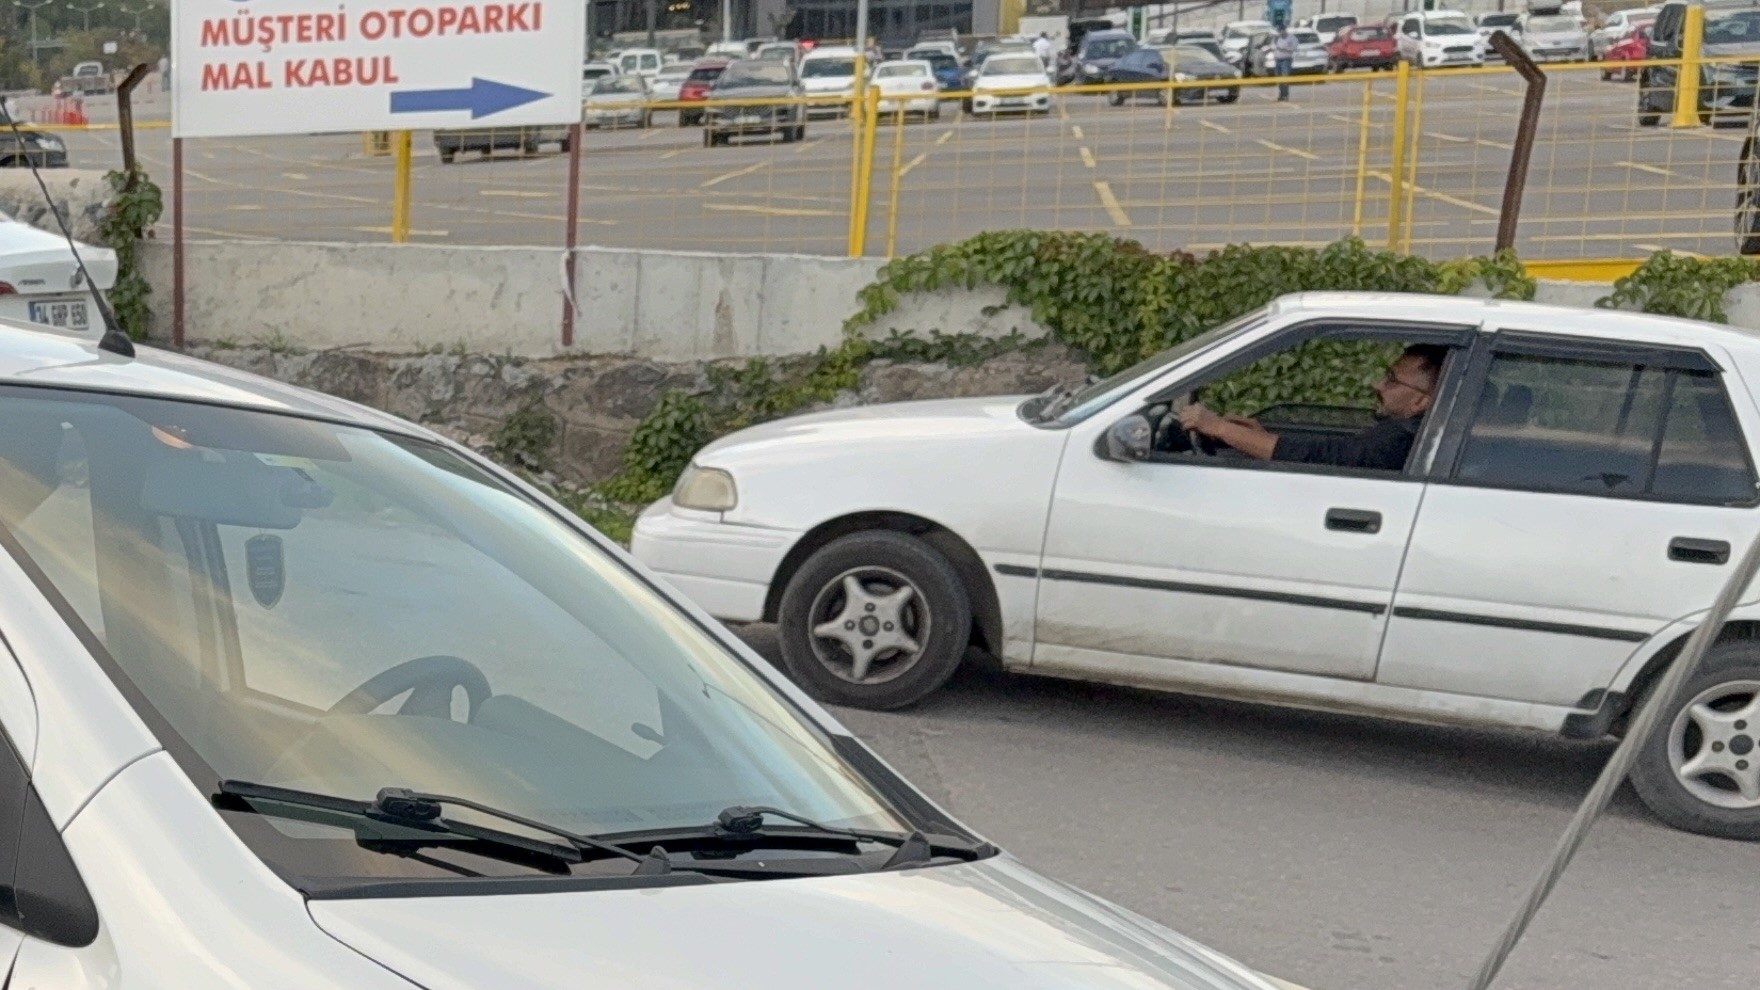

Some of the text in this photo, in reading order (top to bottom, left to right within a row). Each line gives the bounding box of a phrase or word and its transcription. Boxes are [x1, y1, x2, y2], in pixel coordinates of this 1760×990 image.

[200, 2, 543, 53] MÜŞTERİ OTOPARKI
[201, 55, 399, 91] MAL KABUL
